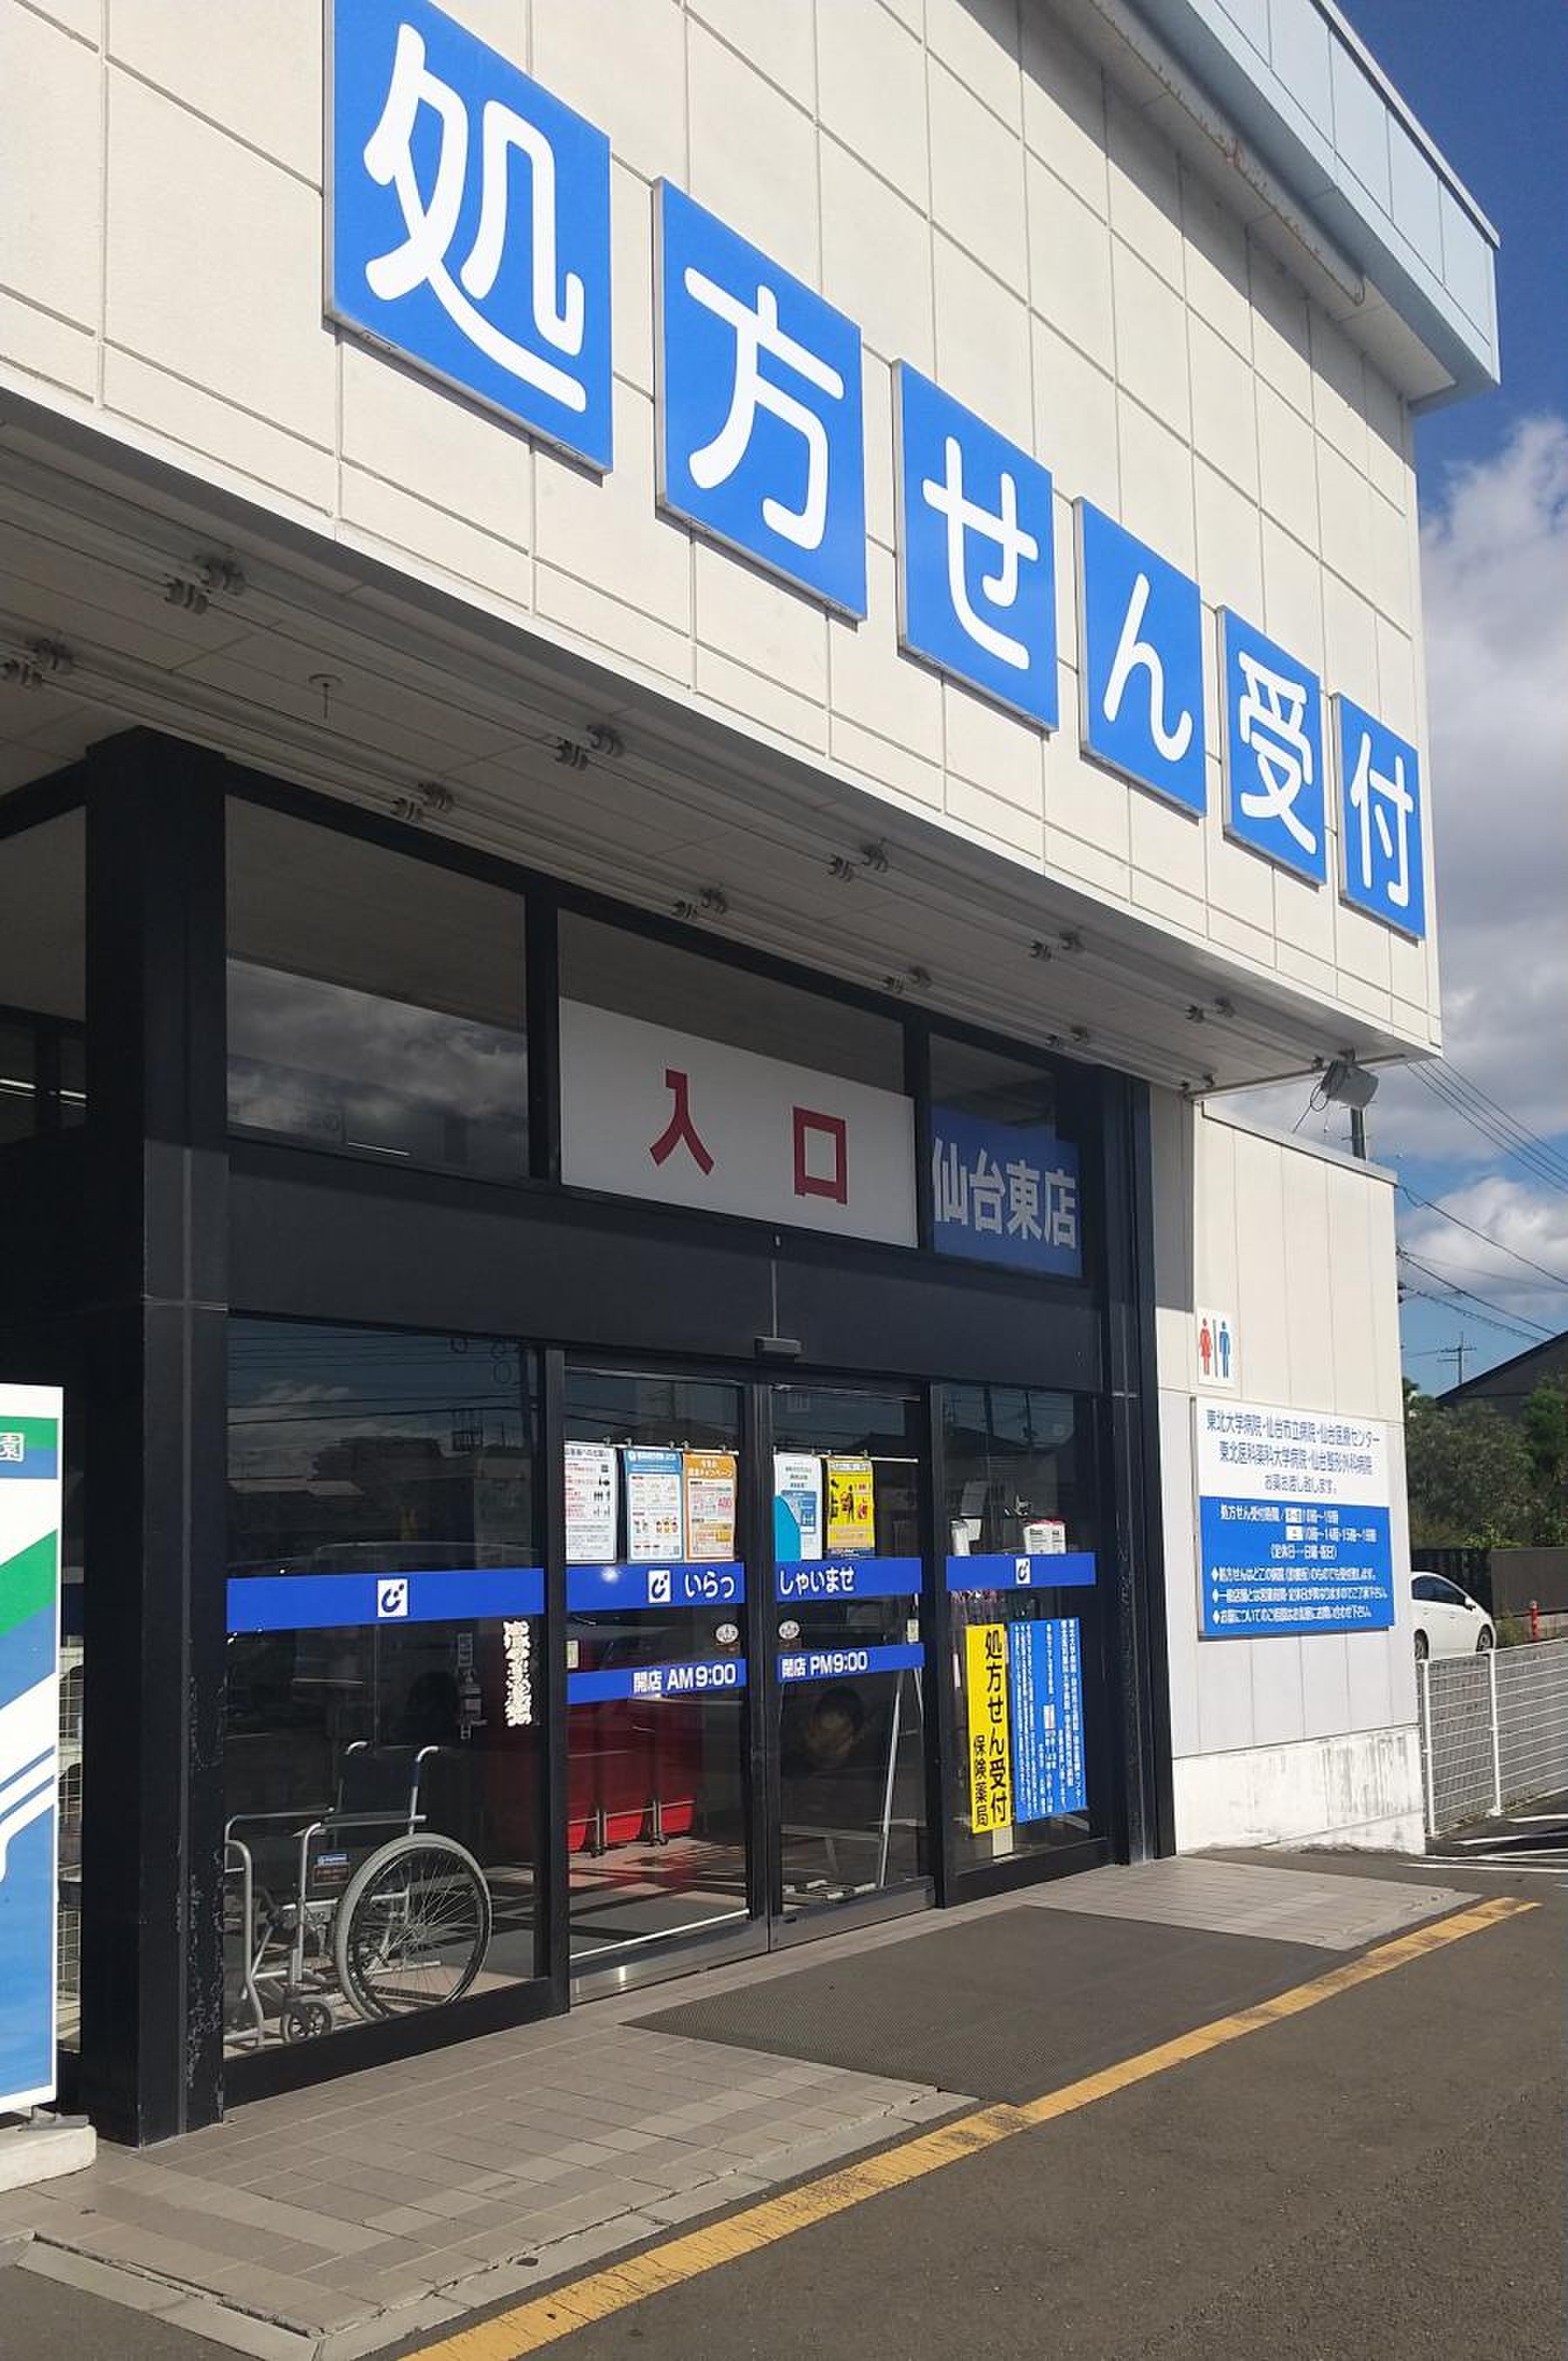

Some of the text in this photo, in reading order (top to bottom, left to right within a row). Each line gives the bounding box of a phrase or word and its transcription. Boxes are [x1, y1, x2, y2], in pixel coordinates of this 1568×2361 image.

[364, 23, 1414, 907] 処方せん受付
[650, 1068, 847, 1204] 入口
[932, 1138, 1077, 1249] 仙台東店
[684, 1572, 735, 1599] いらっ
[780, 1566, 855, 1595] しゃいませ
[984, 1629, 1007, 1823] 処方せん受付
